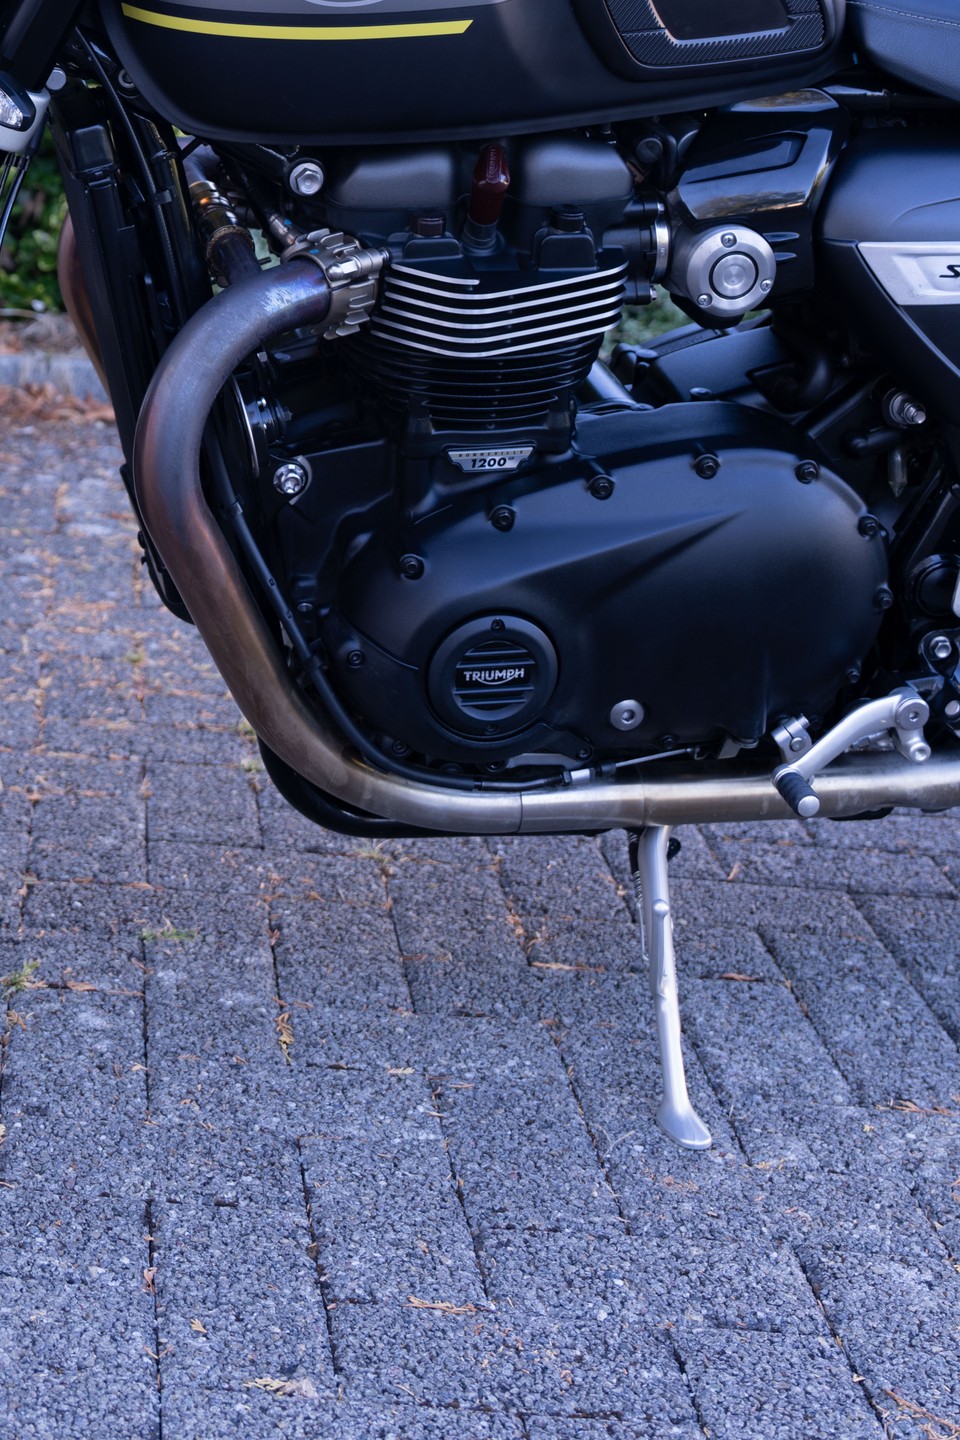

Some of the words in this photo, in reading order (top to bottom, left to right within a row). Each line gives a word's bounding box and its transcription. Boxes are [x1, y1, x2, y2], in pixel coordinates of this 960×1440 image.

[458, 450, 524, 458] BONNEVILLE
[471, 457, 507, 469] 1200
[464, 667, 525, 685] TRIUMPH
